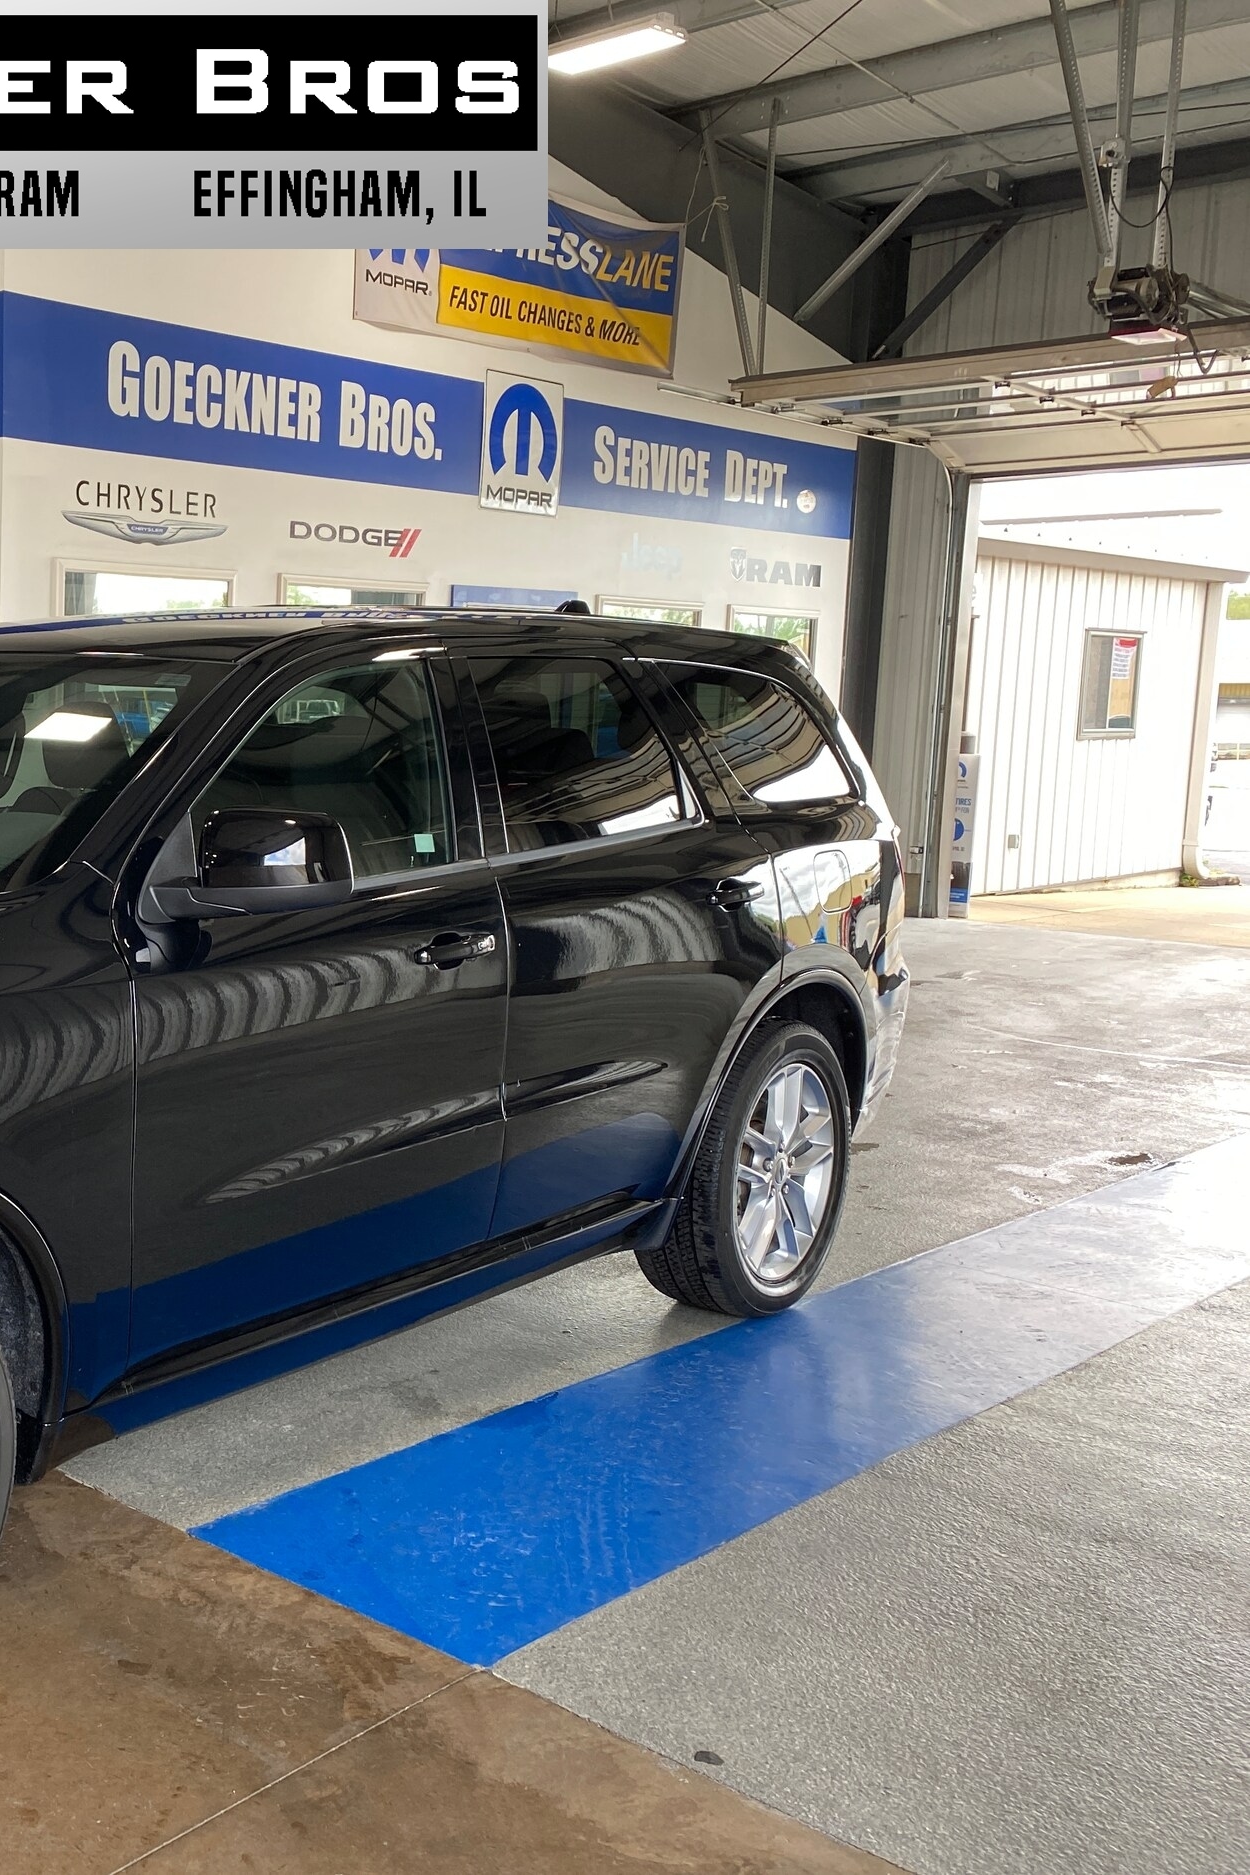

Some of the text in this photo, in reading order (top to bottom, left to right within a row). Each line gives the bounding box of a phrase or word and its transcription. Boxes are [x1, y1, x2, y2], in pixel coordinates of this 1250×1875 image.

[365, 268, 429, 296] MOPAR
[450, 285, 641, 346] FAST OIL CHANGES & MORE
[107, 340, 443, 461] GOECKNER BROS.
[593, 425, 788, 509] SERVICE DEPT.
[75, 479, 218, 519] CHRYSLER
[486, 484, 553, 509] MOPAR
[289, 519, 404, 548] DODGE
[746, 558, 822, 588] RAM
